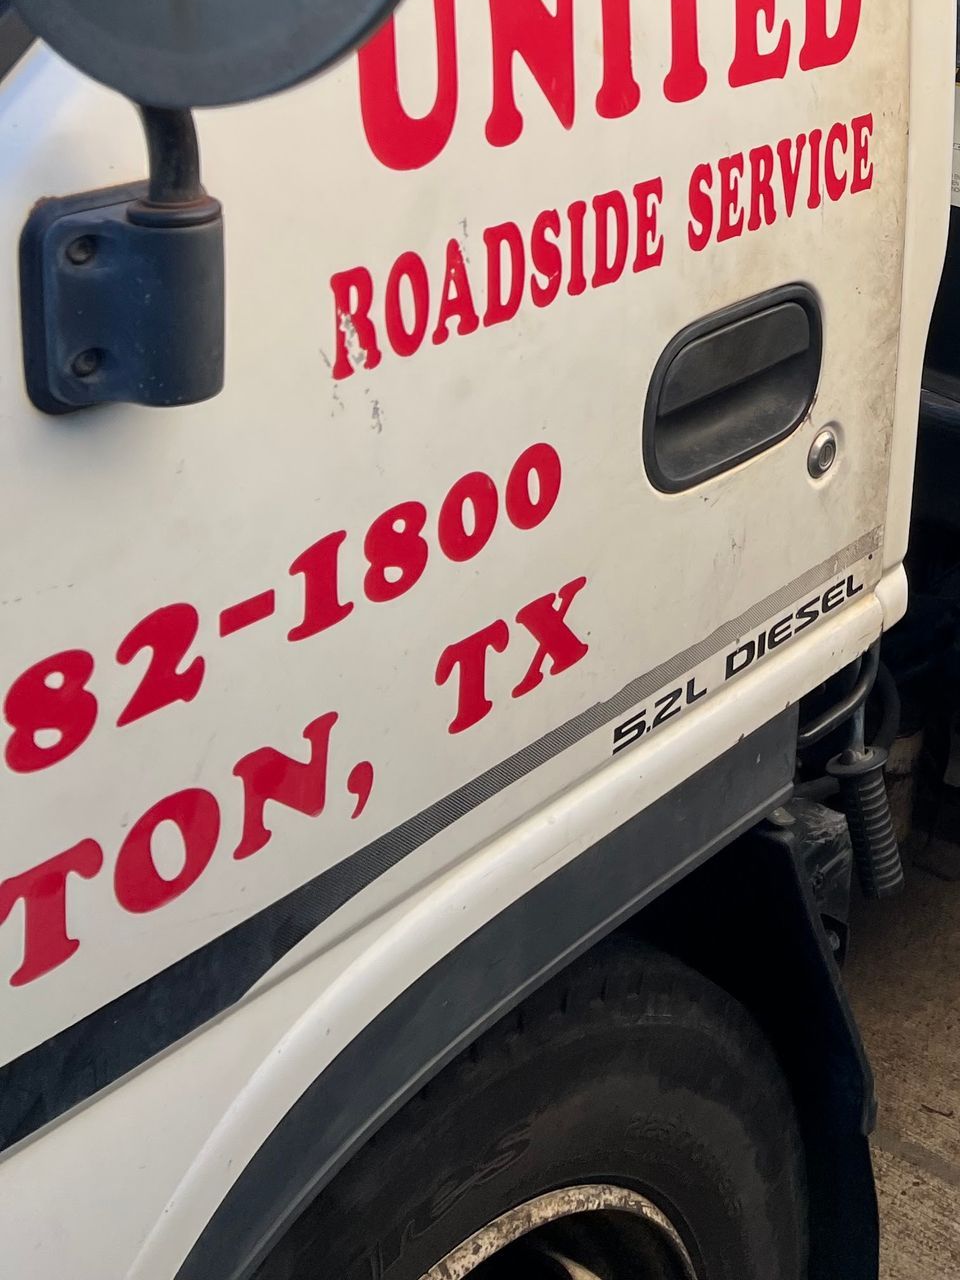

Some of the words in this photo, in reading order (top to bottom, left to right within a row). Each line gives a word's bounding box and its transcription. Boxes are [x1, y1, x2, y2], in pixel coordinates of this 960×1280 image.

[331, 176, 664, 380] ROADSIDE
[688, 112, 874, 252] SERVICE
[4, 443, 562, 773] 82-1800
[612, 677, 707, 756] 5.2L
[724, 574, 864, 681] DIESEL
[0, 711, 374, 986] TON,
[436, 577, 589, 734] TX
